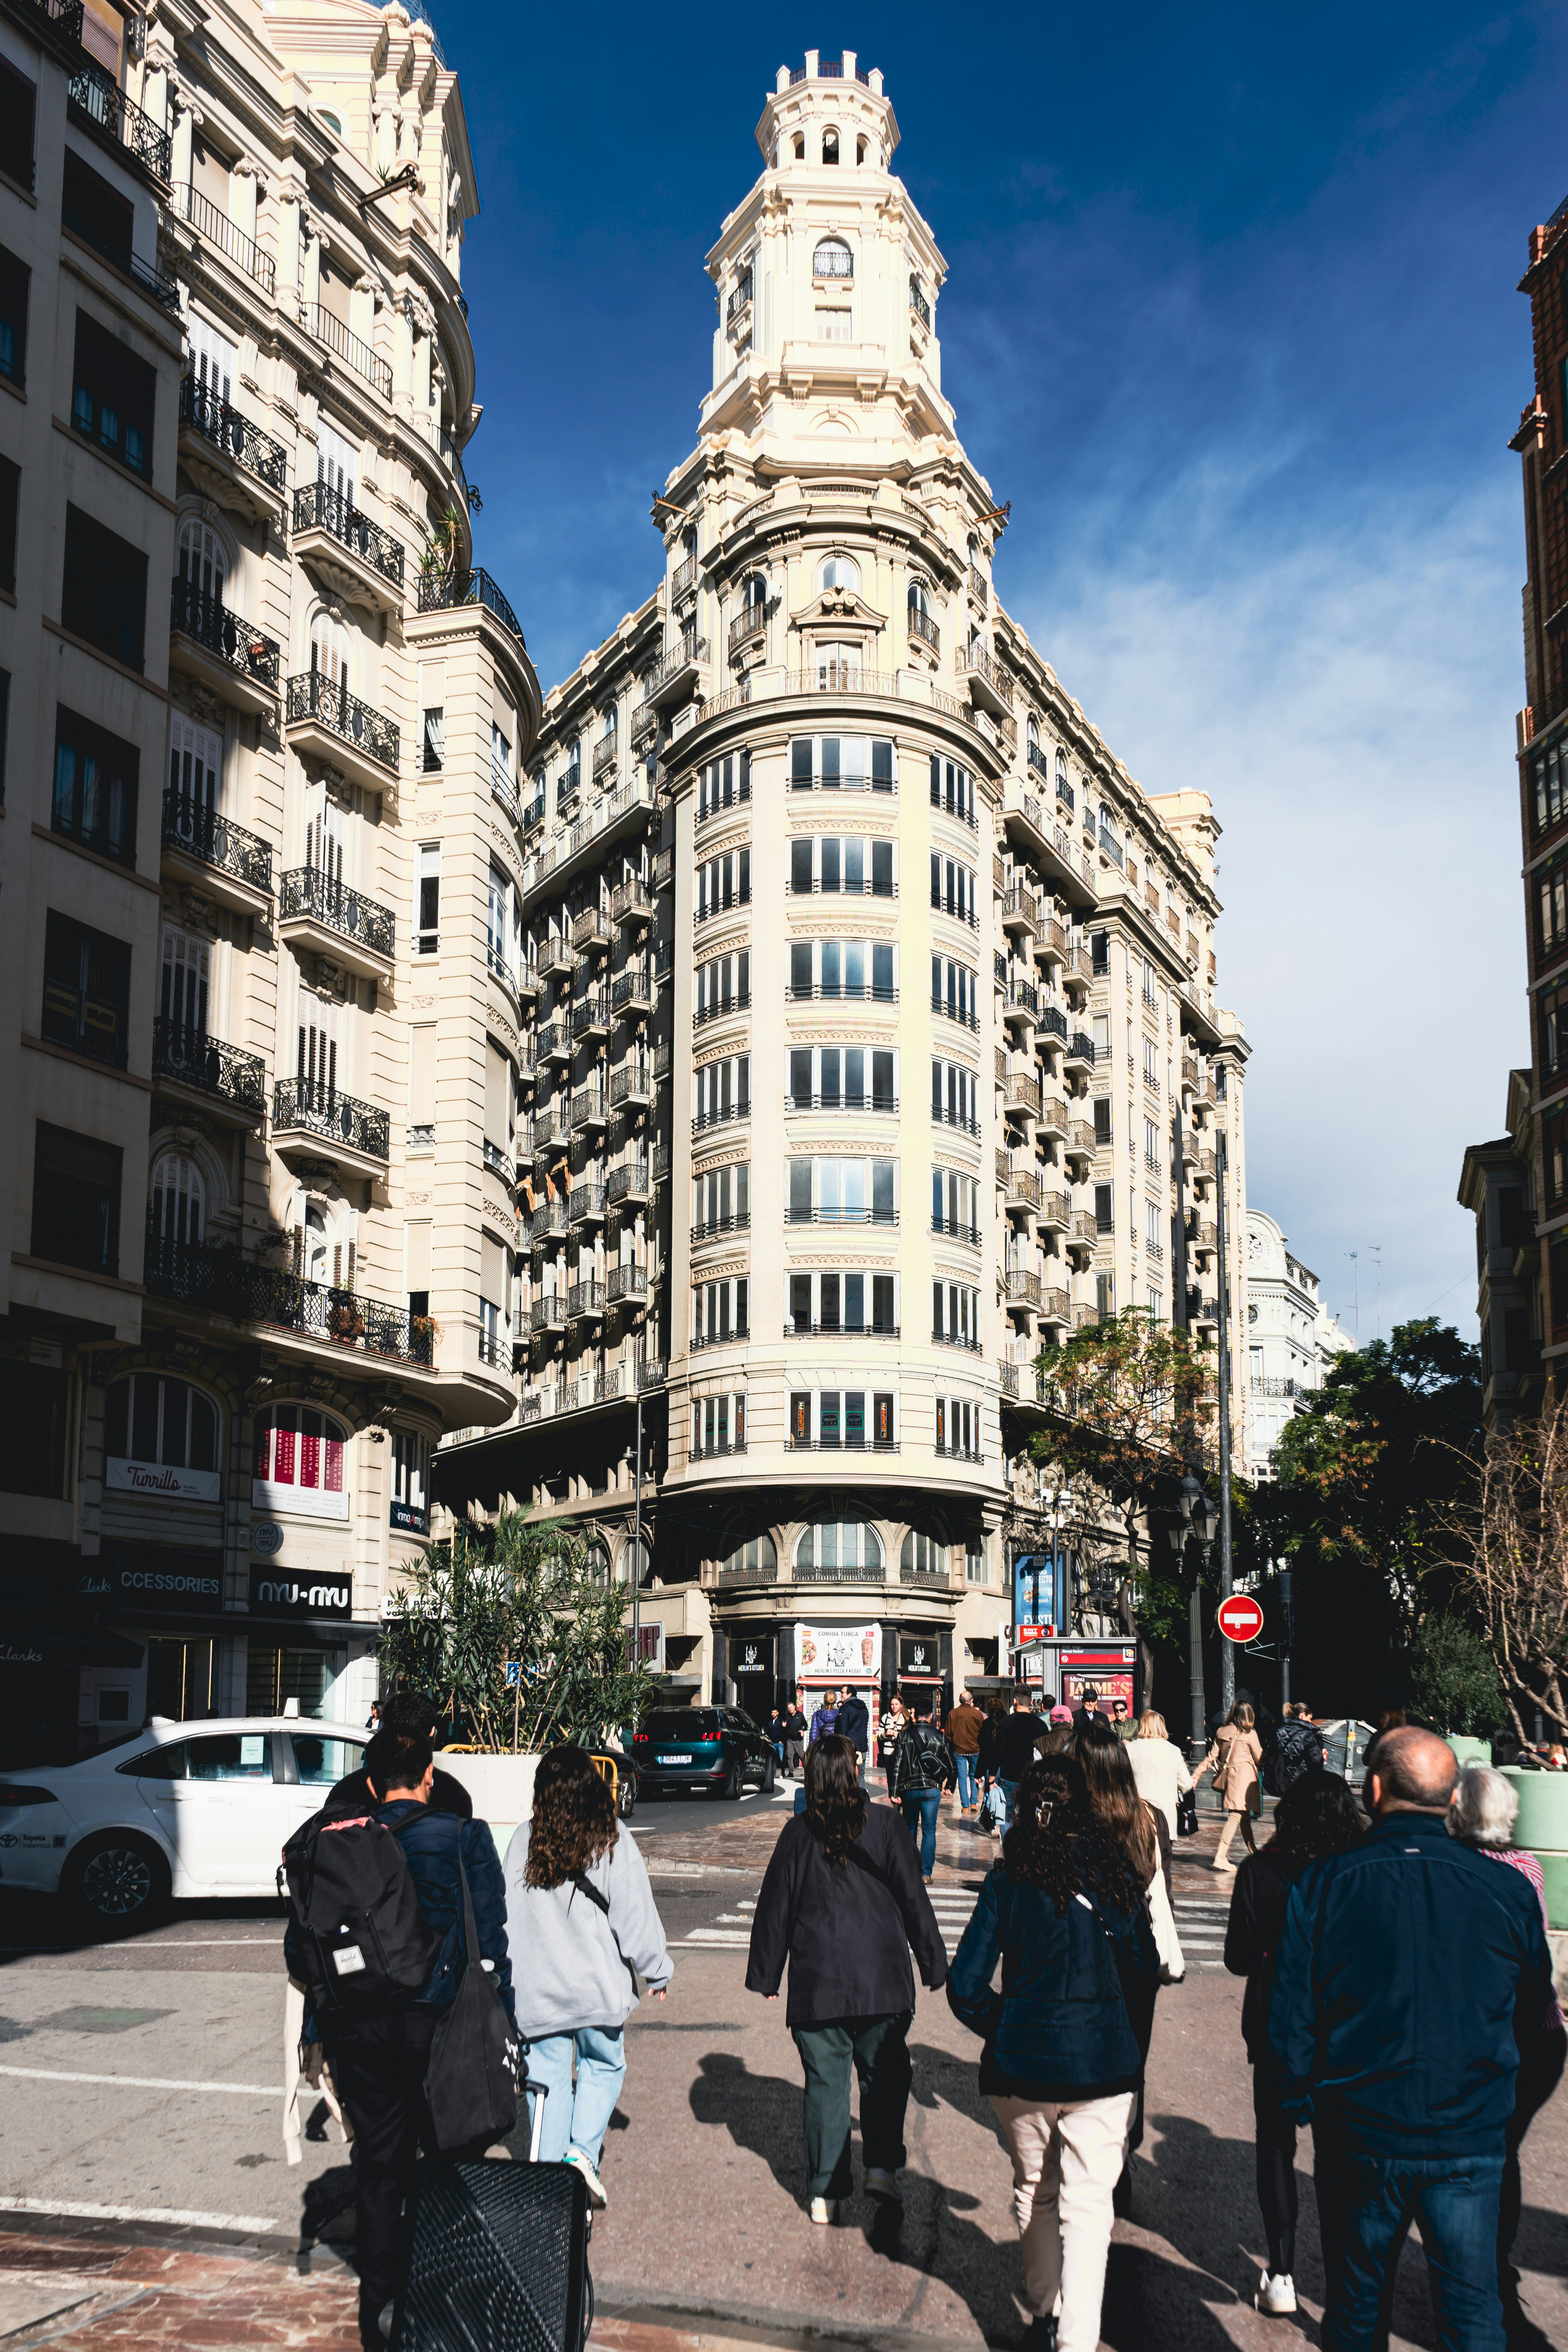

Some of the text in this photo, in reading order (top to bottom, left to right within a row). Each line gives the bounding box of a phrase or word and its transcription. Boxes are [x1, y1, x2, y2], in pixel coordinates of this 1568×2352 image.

[127, 1466, 181, 1491] Turrillo
[338, 1480, 341, 1489] DE
[76, 1576, 112, 1593] Clarks
[1025, 1575, 1053, 1584] PERFECTO
